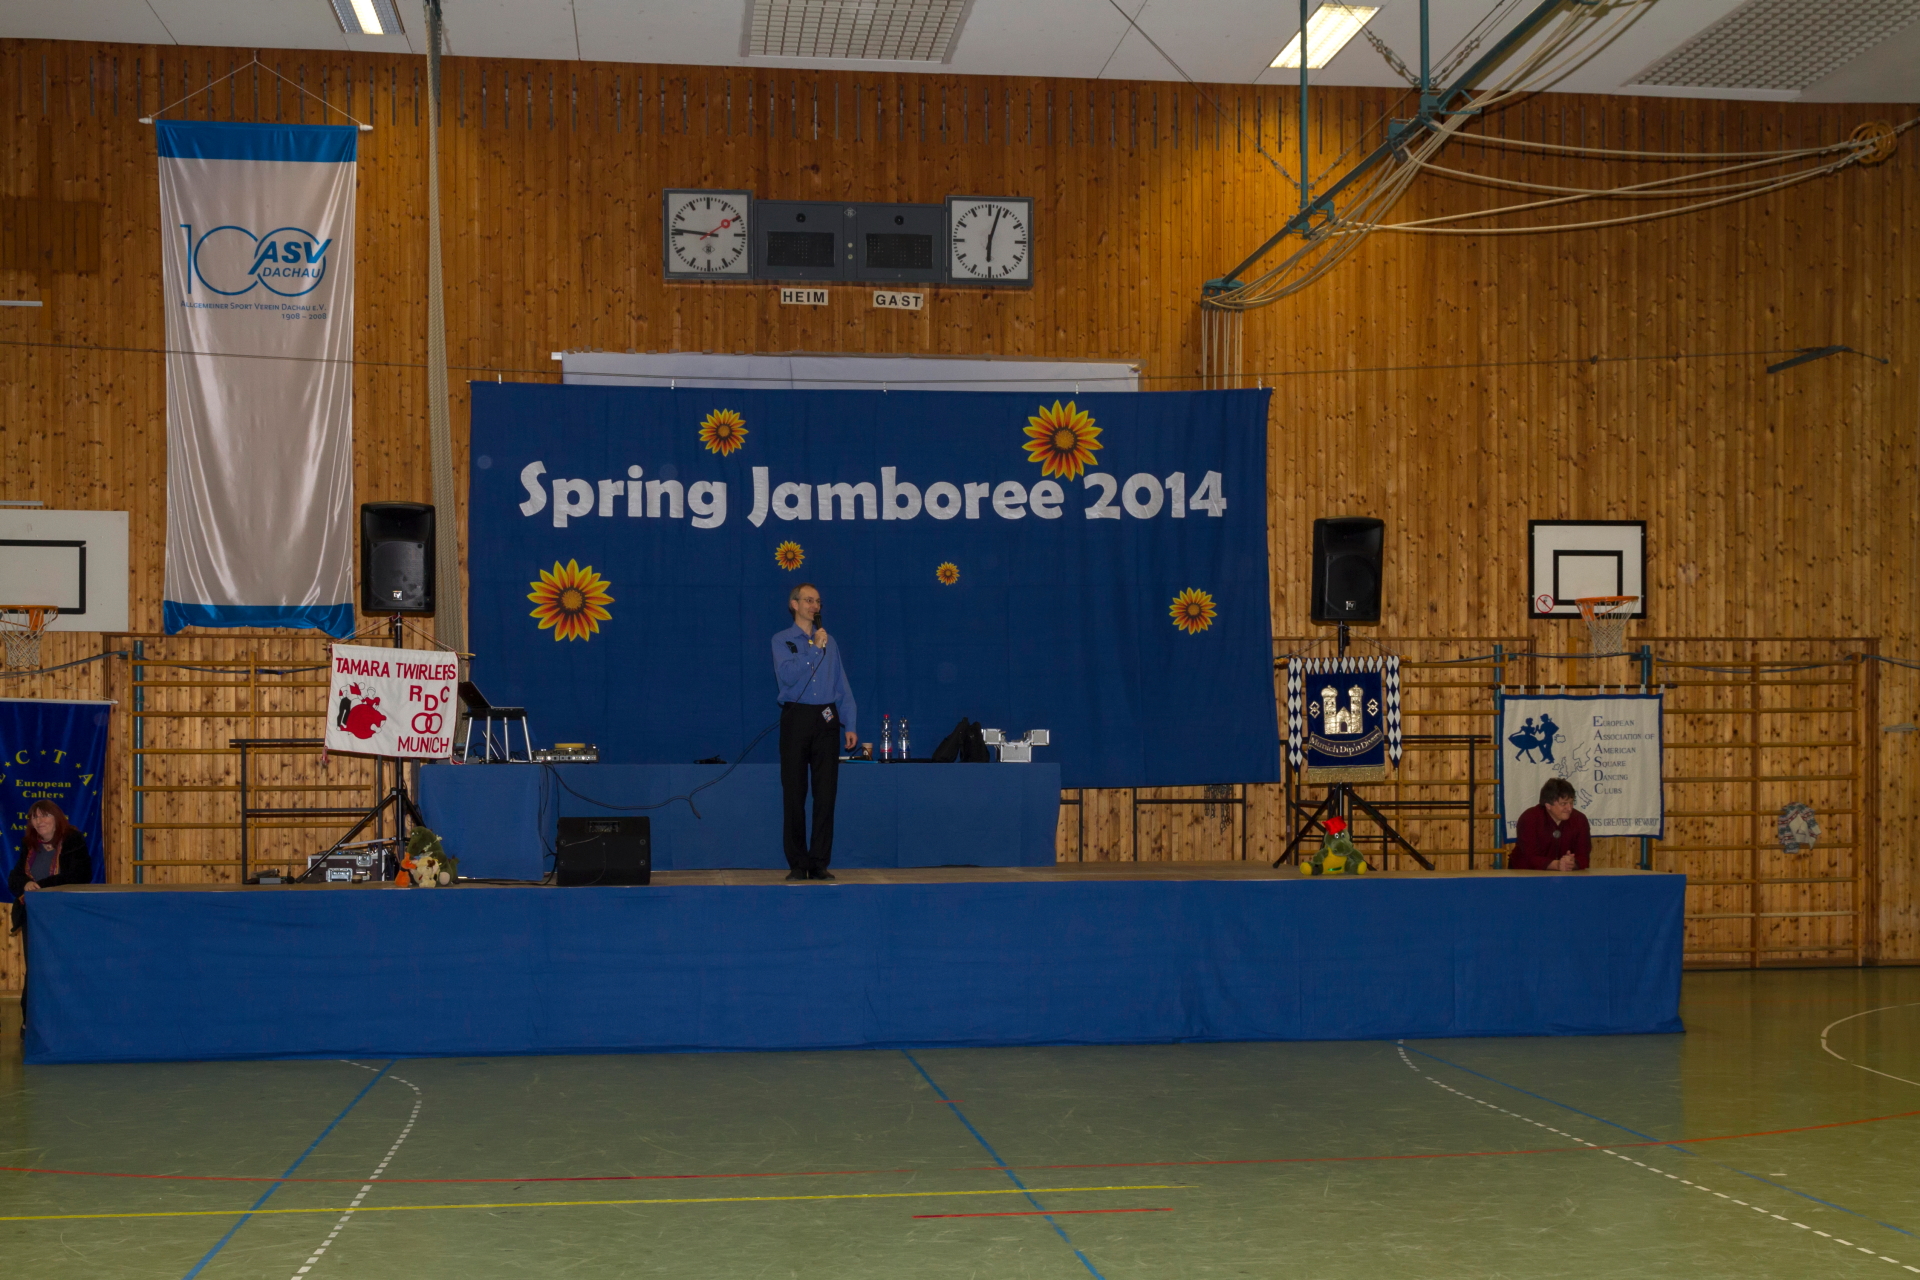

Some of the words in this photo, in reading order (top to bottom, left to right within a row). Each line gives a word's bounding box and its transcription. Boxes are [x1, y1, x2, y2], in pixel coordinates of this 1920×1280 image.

[247, 239, 333, 275] ASV
[262, 267, 321, 278] DACHAU
[783, 291, 825, 303] HEIM
[875, 294, 921, 307] GAST
[519, 460, 727, 529] Spring
[747, 466, 1065, 528] Jamboree
[1083, 470, 1227, 520] 2014
[335, 657, 390, 678] TAMARA
[1592, 715, 1635, 727] EUROPEAN
[1593, 729, 1642, 741] ASSOCIATION
[397, 736, 450, 753] MUNICH
[1593, 743, 1636, 755] AMERICAN
[1593, 756, 1627, 768] SQUARE
[1594, 769, 1629, 781] DANCING
[15, 779, 71, 789] European
[1594, 782, 1623, 795] CLUBS
[22, 790, 64, 798] Callers
[1603, 818, 1632, 827] GREATEST
